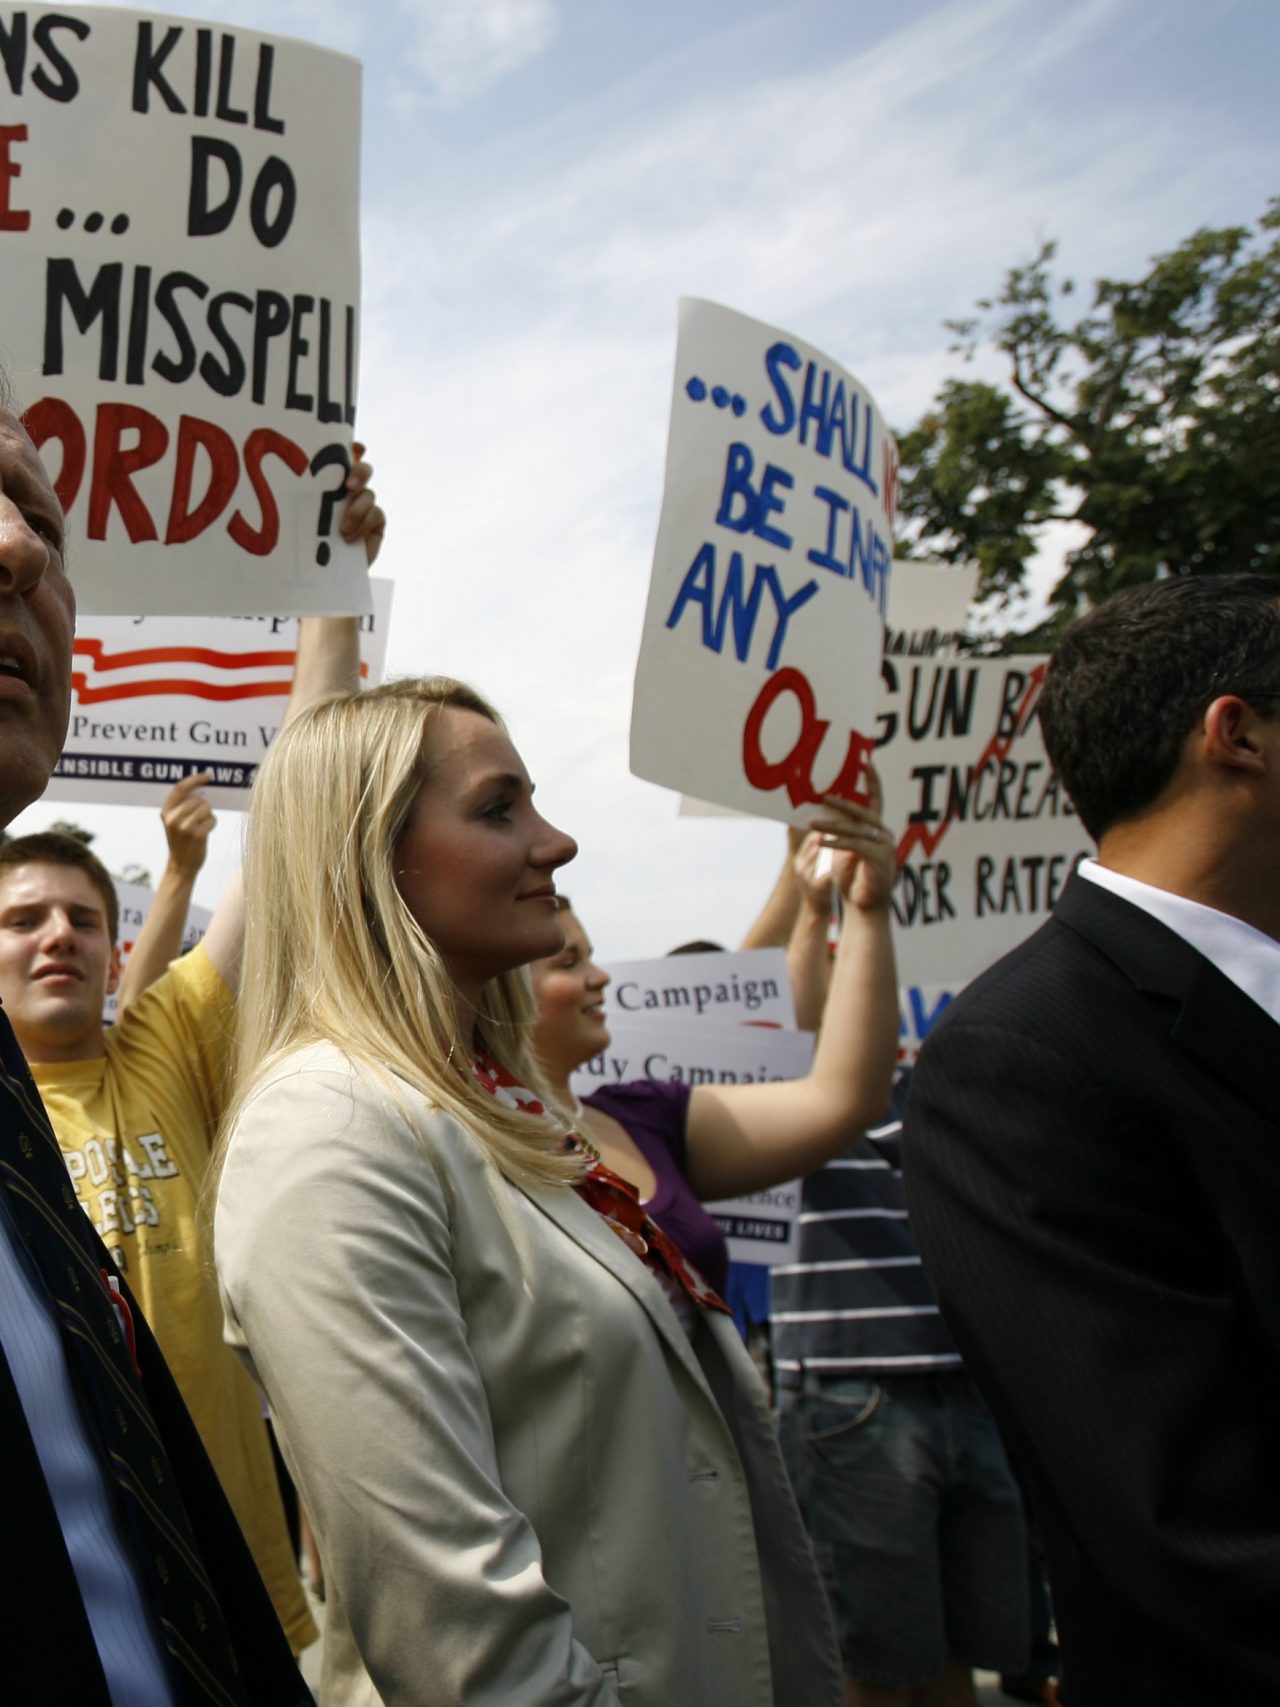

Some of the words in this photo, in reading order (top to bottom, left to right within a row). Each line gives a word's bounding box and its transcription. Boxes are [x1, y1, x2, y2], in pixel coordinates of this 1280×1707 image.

[132, 20, 285, 135] KILL
[187, 135, 296, 248] DO
[42, 257, 356, 427] MISSPELL
[19, 397, 351, 567] ORDS?
[716, 442, 794, 550] BE
[666, 542, 819, 672] ANY
[54, 758, 134, 778] ENSIBLE
[139, 763, 184, 779] GUN
[72, 715, 179, 744] Prevent
[189, 721, 248, 747] Gun
[908, 758, 1075, 823] INCREA
[976, 851, 1092, 918] RATE
[616, 974, 781, 1013] Campaign
